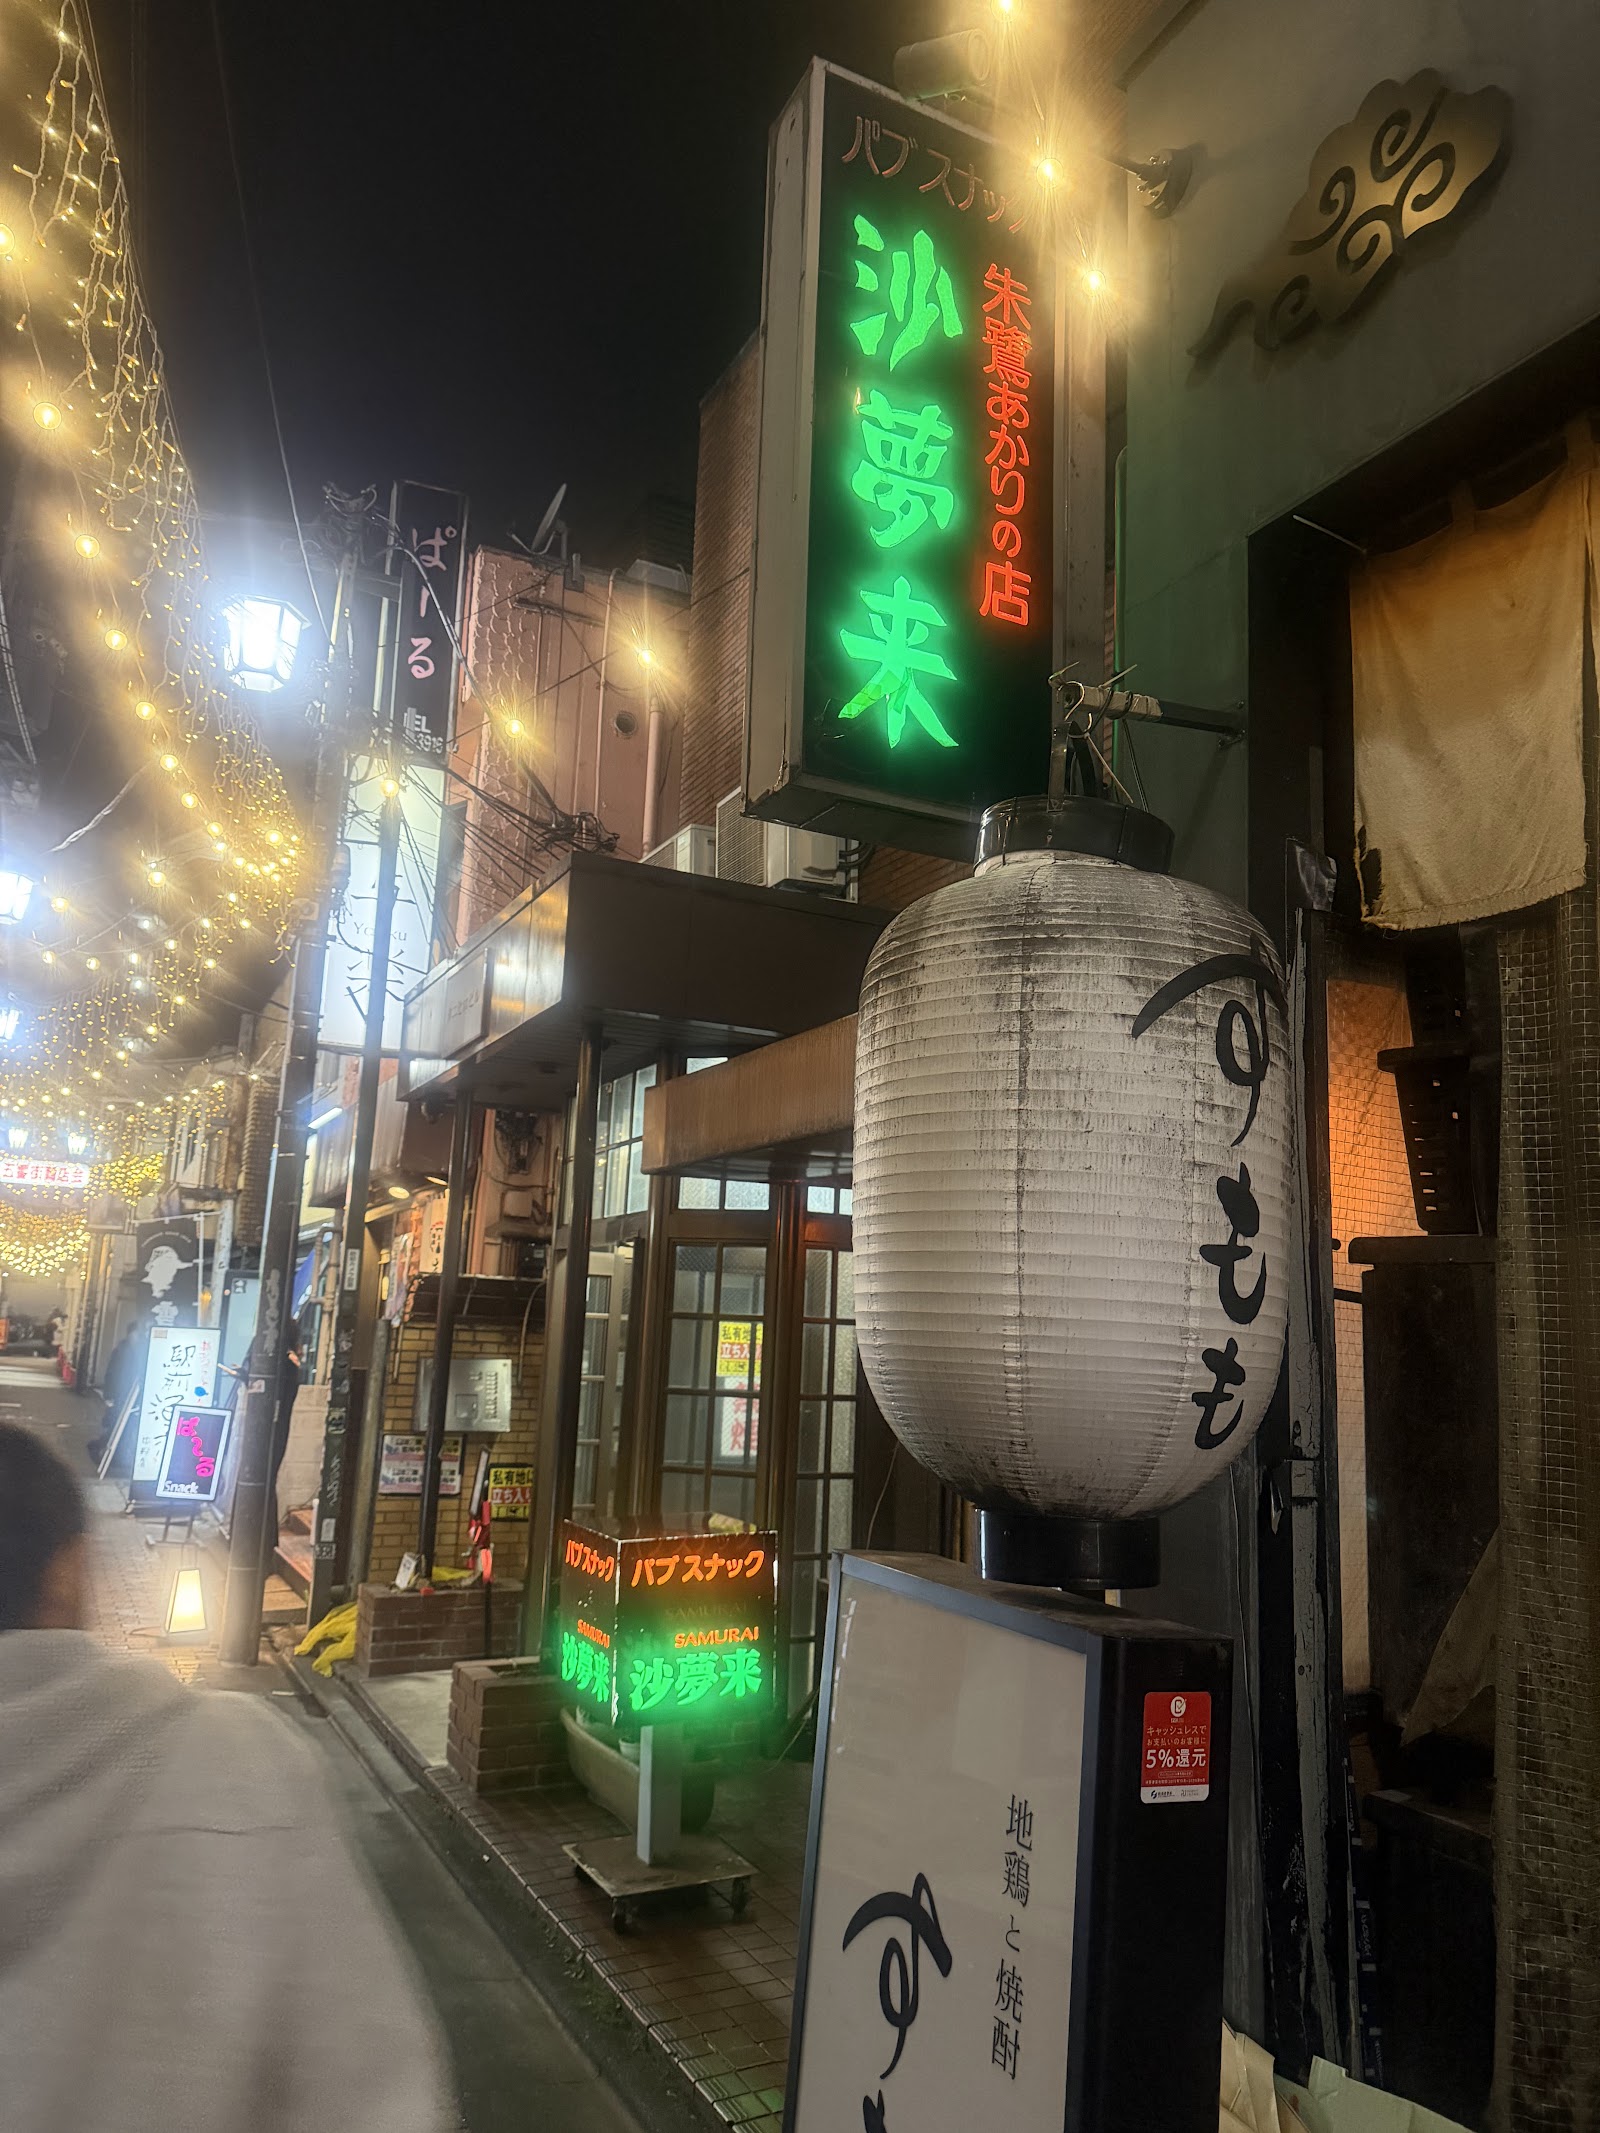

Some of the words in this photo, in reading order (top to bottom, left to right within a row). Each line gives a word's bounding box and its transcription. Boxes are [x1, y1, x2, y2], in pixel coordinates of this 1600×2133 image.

[979, 263, 1032, 627] 朱鷺あかりの店
[838, 214, 963, 749] 沙夢来
[164, 1480, 199, 1494] Snack
[565, 1540, 615, 1582] パブスナック
[631, 1550, 765, 1587] パブスナック
[577, 1619, 610, 1648] SAMURAI
[674, 1626, 760, 1648] SAMURAI
[561, 1632, 610, 1702] 沙夢来
[629, 1648, 763, 1711] 沙夢来
[1147, 1725, 1207, 1737] キャッシュレスで
[1145, 1748, 1206, 1769] 5%還元
[992, 1795, 1033, 2080] 地鶏と焼酎
[842, 1872, 953, 2133] す
